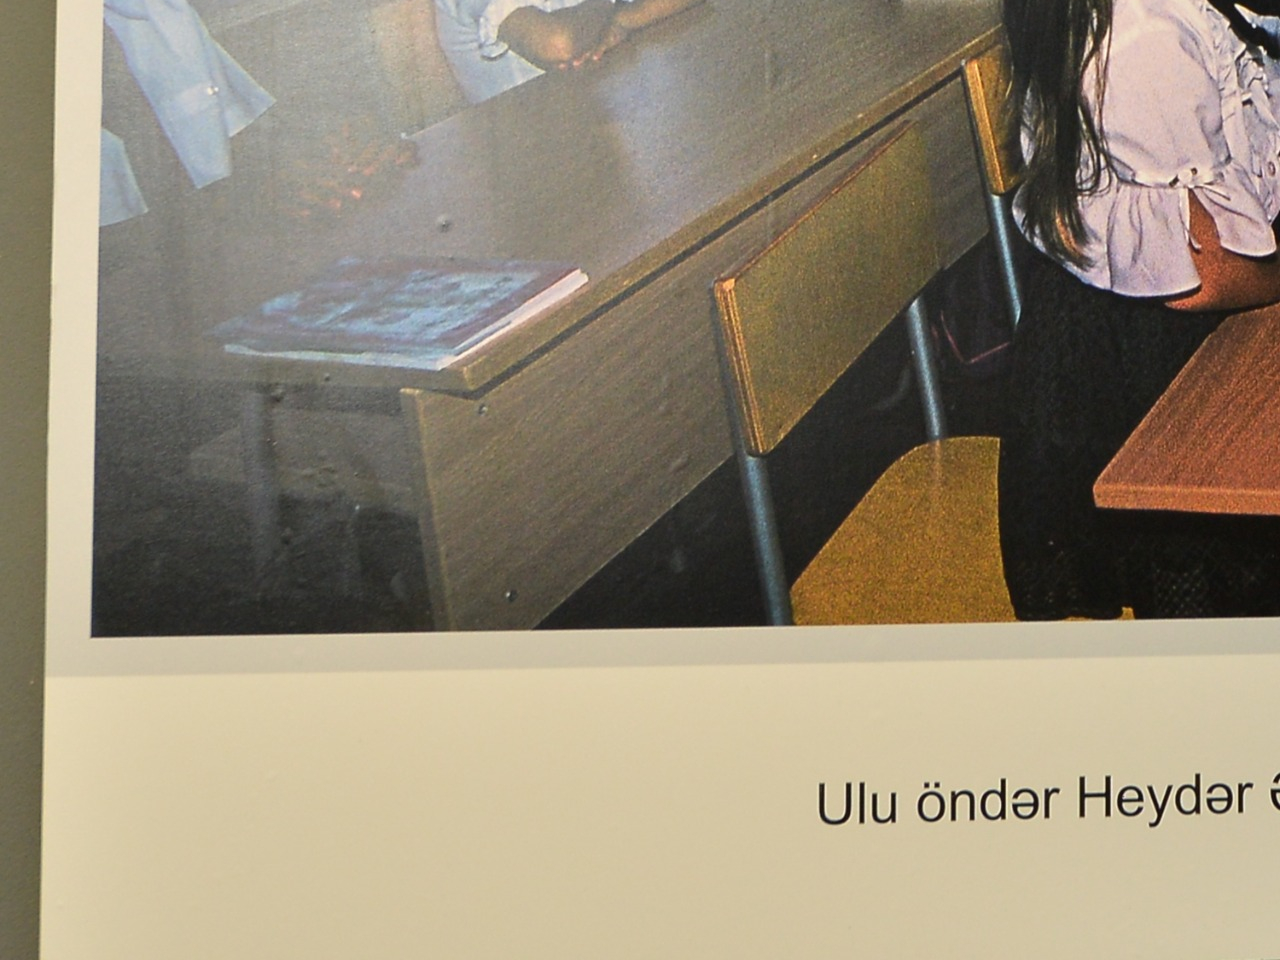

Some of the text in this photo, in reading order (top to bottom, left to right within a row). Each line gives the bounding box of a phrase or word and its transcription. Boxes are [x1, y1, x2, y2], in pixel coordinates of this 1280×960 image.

[818, 782, 897, 826] Ulu
[917, 778, 1061, 823] öndər
[1079, 773, 1254, 828] Heydər
